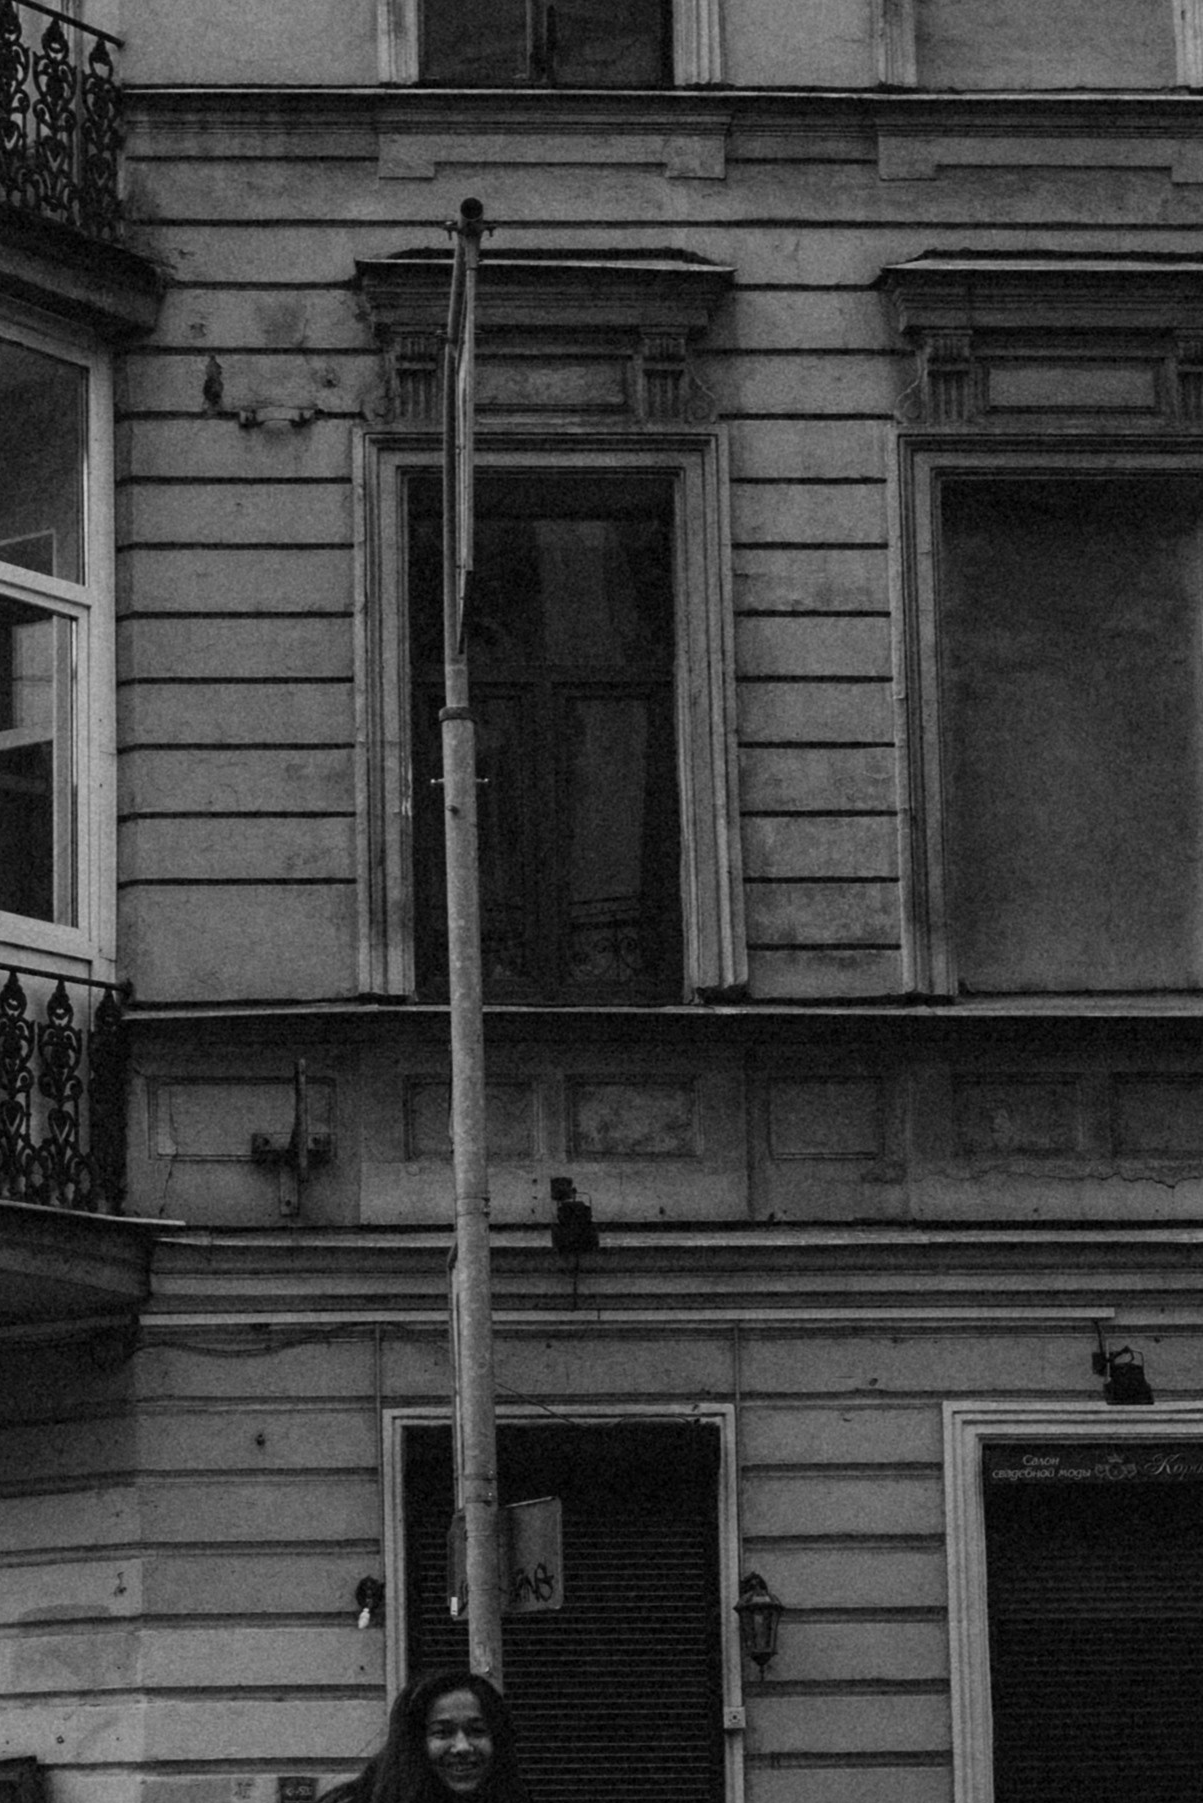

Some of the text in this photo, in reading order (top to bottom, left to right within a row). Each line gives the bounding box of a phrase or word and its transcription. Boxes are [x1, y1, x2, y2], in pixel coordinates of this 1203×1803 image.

[1022, 1454, 1060, 1467] Салон
[991, 1466, 1091, 1481] свадебной моды
